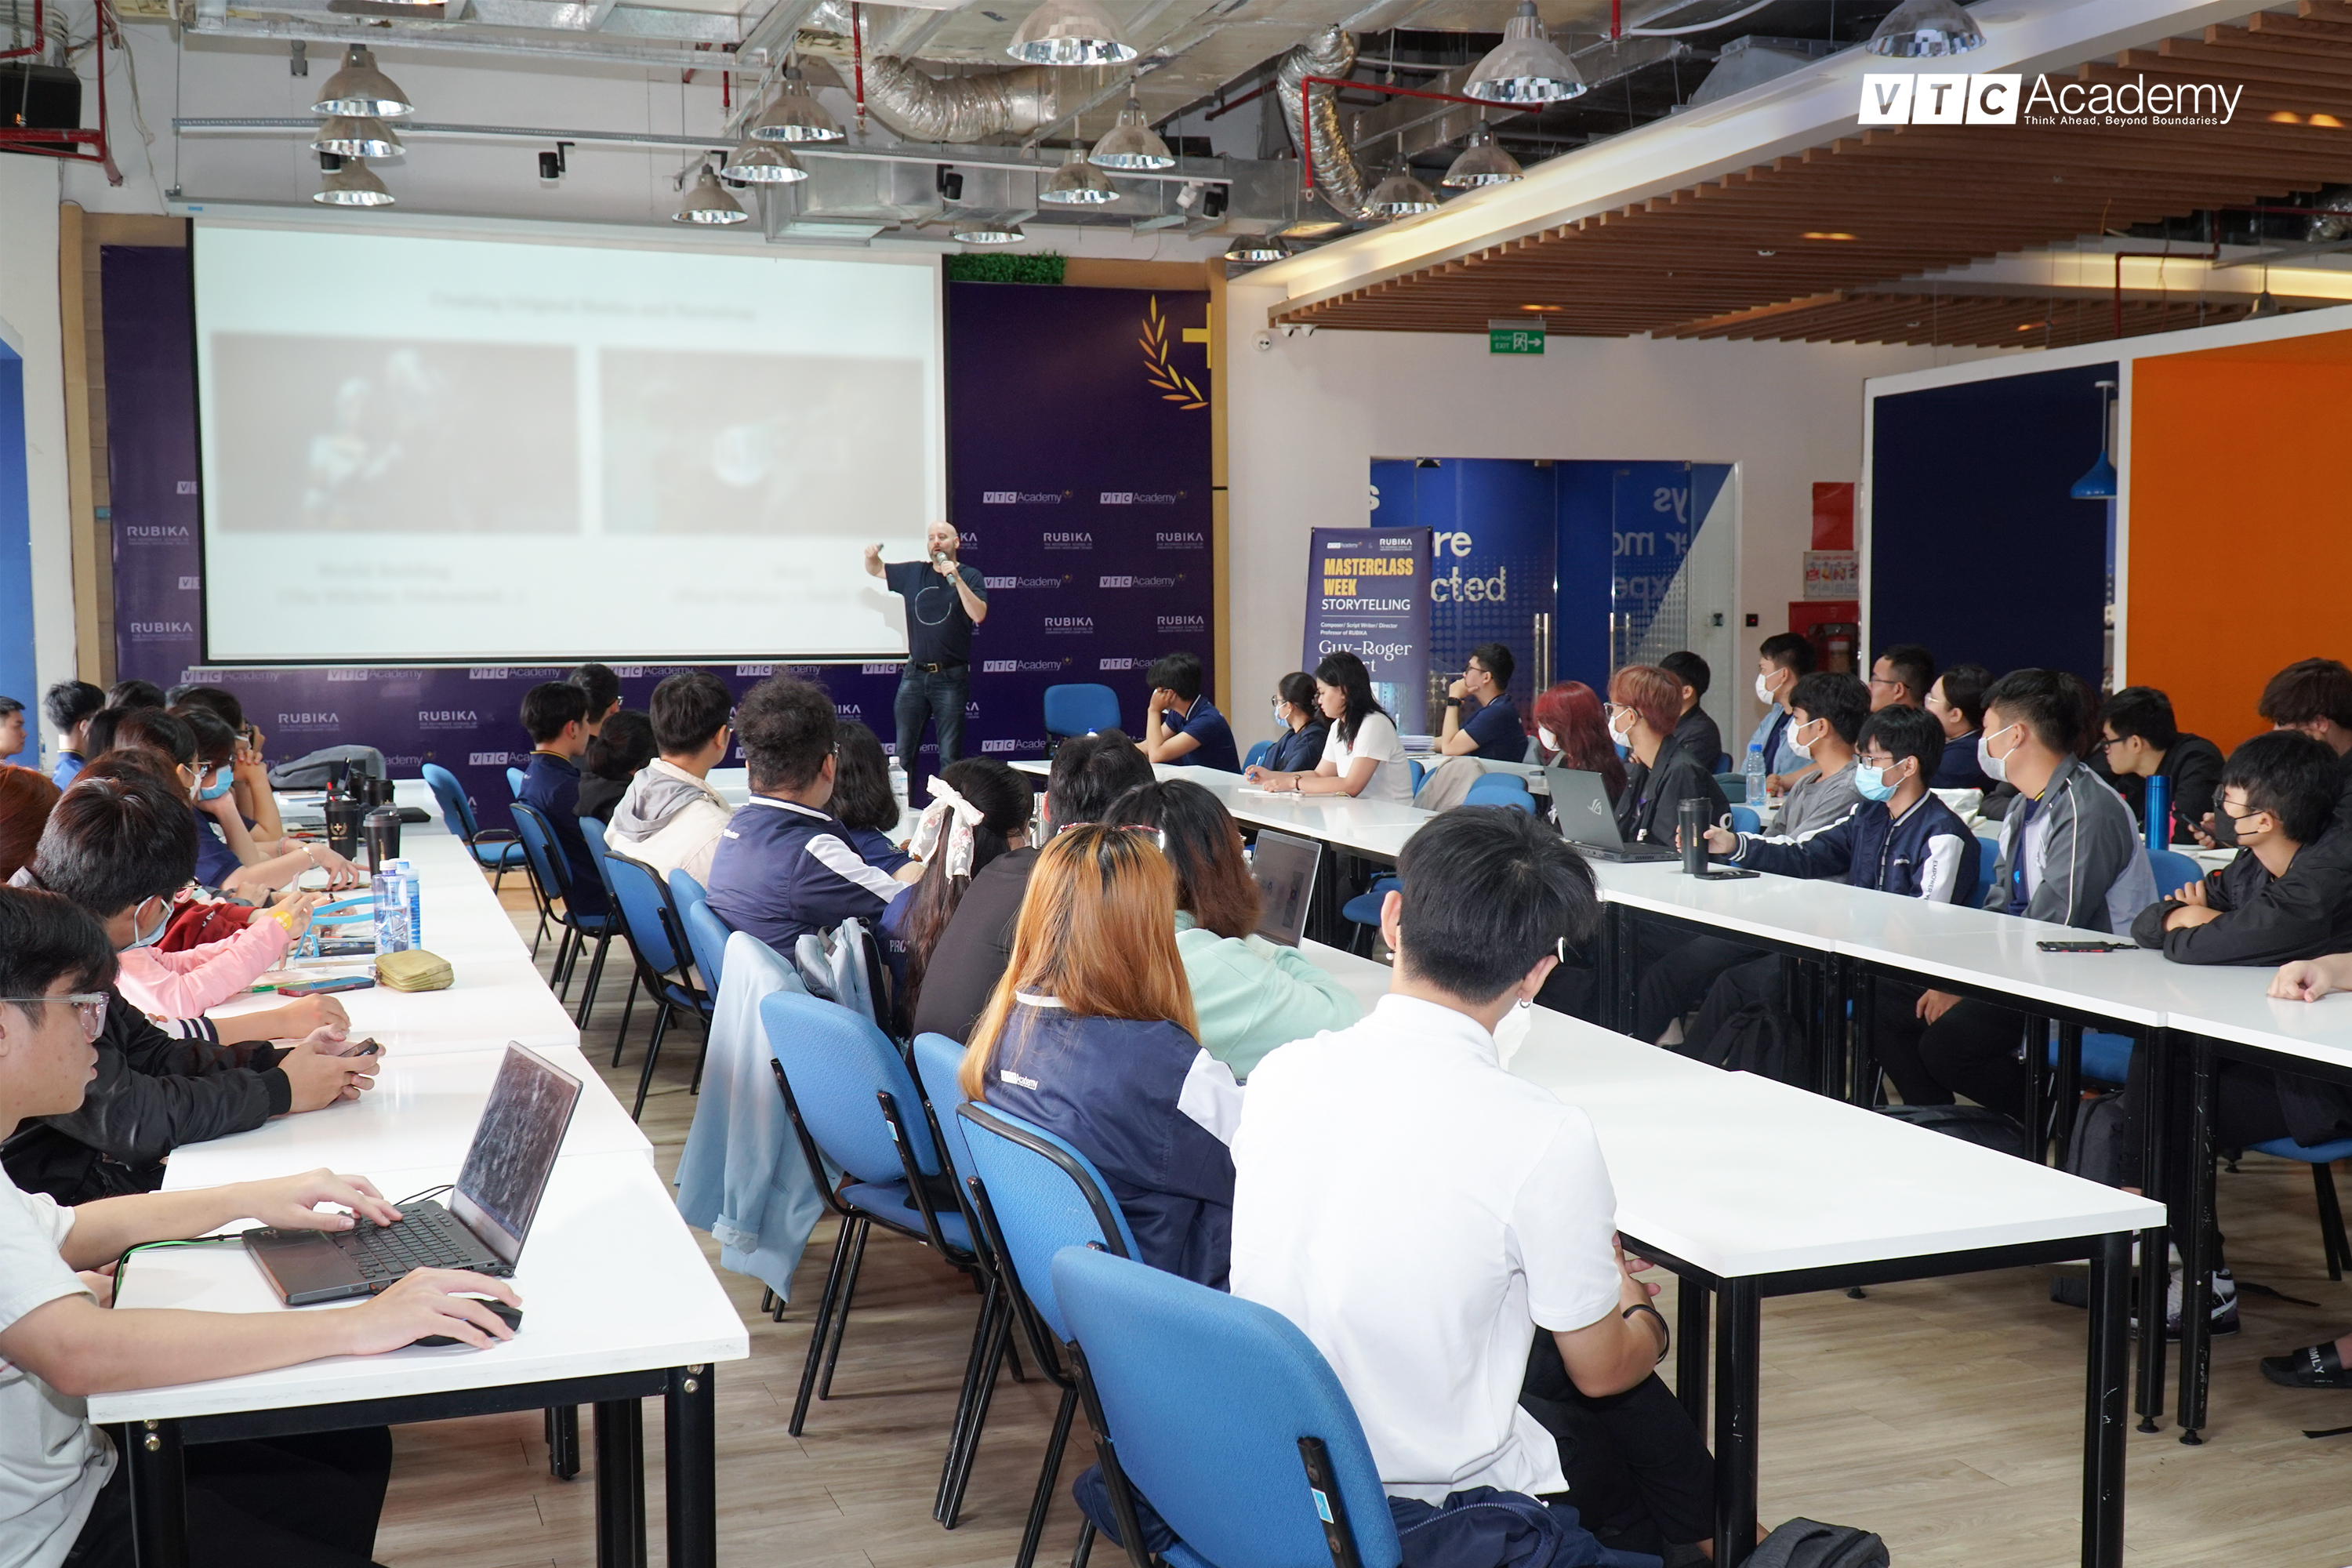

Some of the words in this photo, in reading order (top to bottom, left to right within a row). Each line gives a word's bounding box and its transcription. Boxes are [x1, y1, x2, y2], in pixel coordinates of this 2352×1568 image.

[984, 492, 1016, 503] VTC
[1018, 492, 1062, 504] Academy
[1101, 493, 1132, 503] VTC
[1133, 492, 1176, 504] Academy
[128, 526, 189, 537] RUBIKA
[1044, 532, 1093, 542] RUBIKA
[1156, 532, 1204, 542] RUBIKA
[1432, 532, 1472, 557] re
[1323, 557, 1414, 576] MASTERCLASS
[985, 578, 1016, 588] VTC
[1017, 576, 1062, 588] Academy
[1100, 576, 1132, 587] VTC
[1132, 575, 1176, 587] Academy
[1323, 578, 1357, 596] WEEK
[1431, 566, 1506, 602] cted
[1321, 598, 1410, 611] STORYTELLING
[1045, 617, 1094, 626] RUBIKA
[1157, 615, 1204, 625] RUBIKA
[131, 622, 193, 633] RUBIKA
[863, 664, 895, 674] VTC
[984, 661, 1016, 672] VTC
[1017, 660, 1062, 672] Academy
[1101, 659, 1131, 670] VTC
[1132, 658, 1157, 667] Acad
[328, 670, 367, 681] VTC
[368, 668, 422, 680] Academy
[470, 668, 507, 679] VTC
[509, 667, 561, 678] Academy
[737, 665, 772, 676] VTC
[181, 671, 221, 683] VTC
[278, 713, 339, 724] RUBIKA
[419, 710, 477, 721] RUBIKA
[982, 740, 1014, 751] VTC
[1015, 739, 1049, 749] Acade
[386, 756, 422, 768] ademy
[470, 753, 507, 764] VTC
[1928, 860, 1938, 893] EMPOWER
